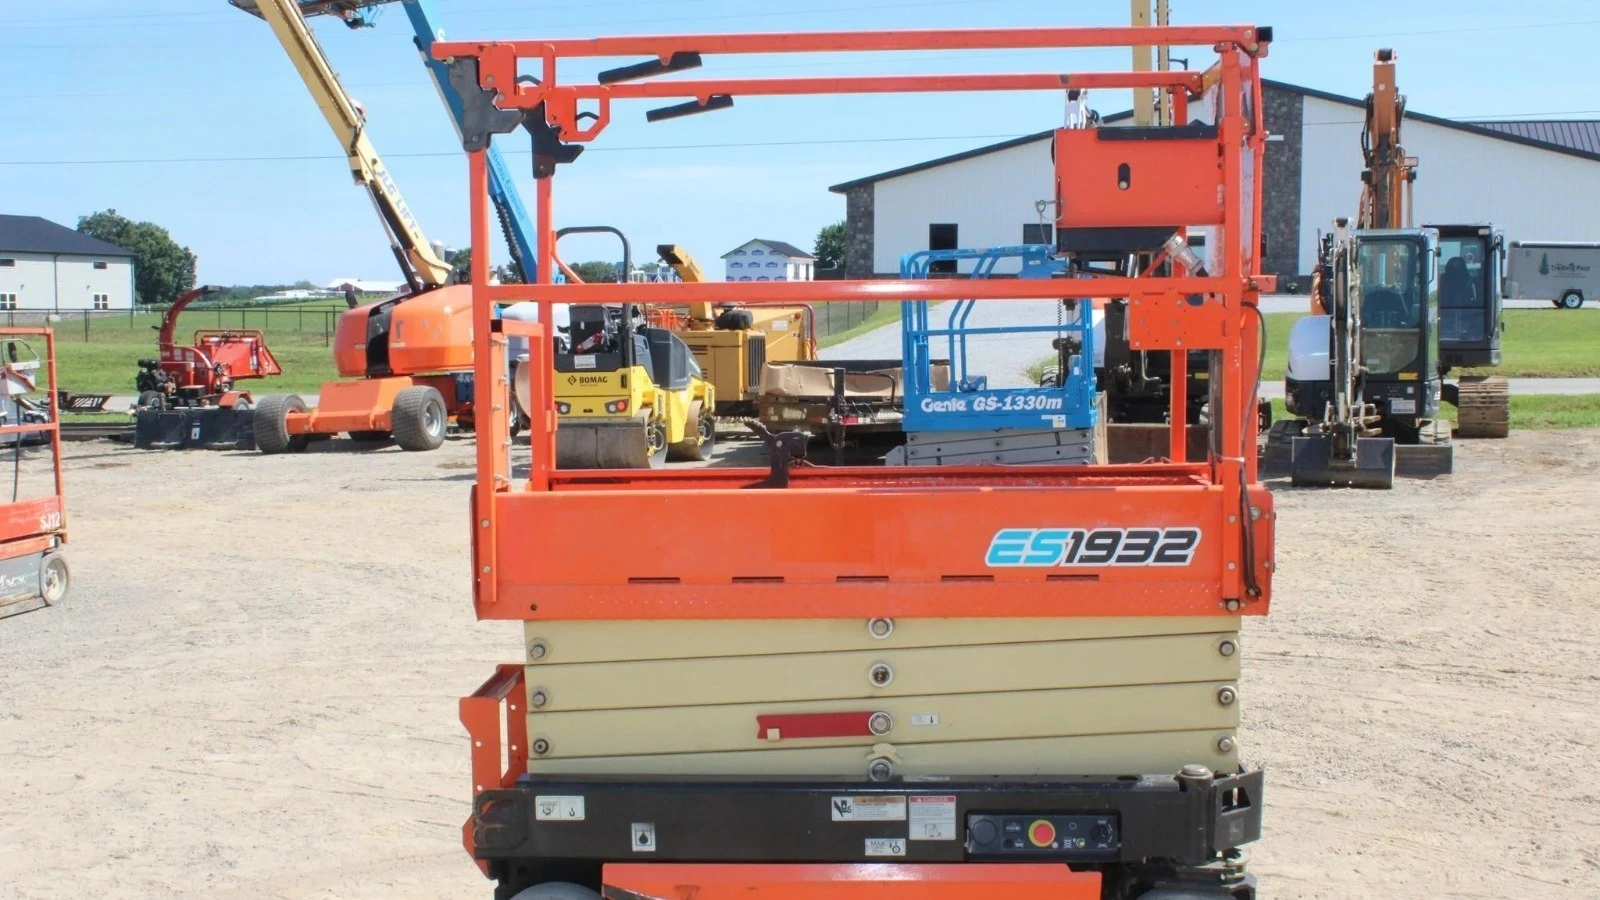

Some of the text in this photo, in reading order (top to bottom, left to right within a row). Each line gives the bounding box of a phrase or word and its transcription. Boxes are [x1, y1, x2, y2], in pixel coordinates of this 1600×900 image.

[378, 170, 417, 230] JLG LIFT
[579, 376, 608, 384] BOMAG
[920, 395, 1063, 412] Genie GS-1330m
[986, 528, 1201, 565] ES1932
